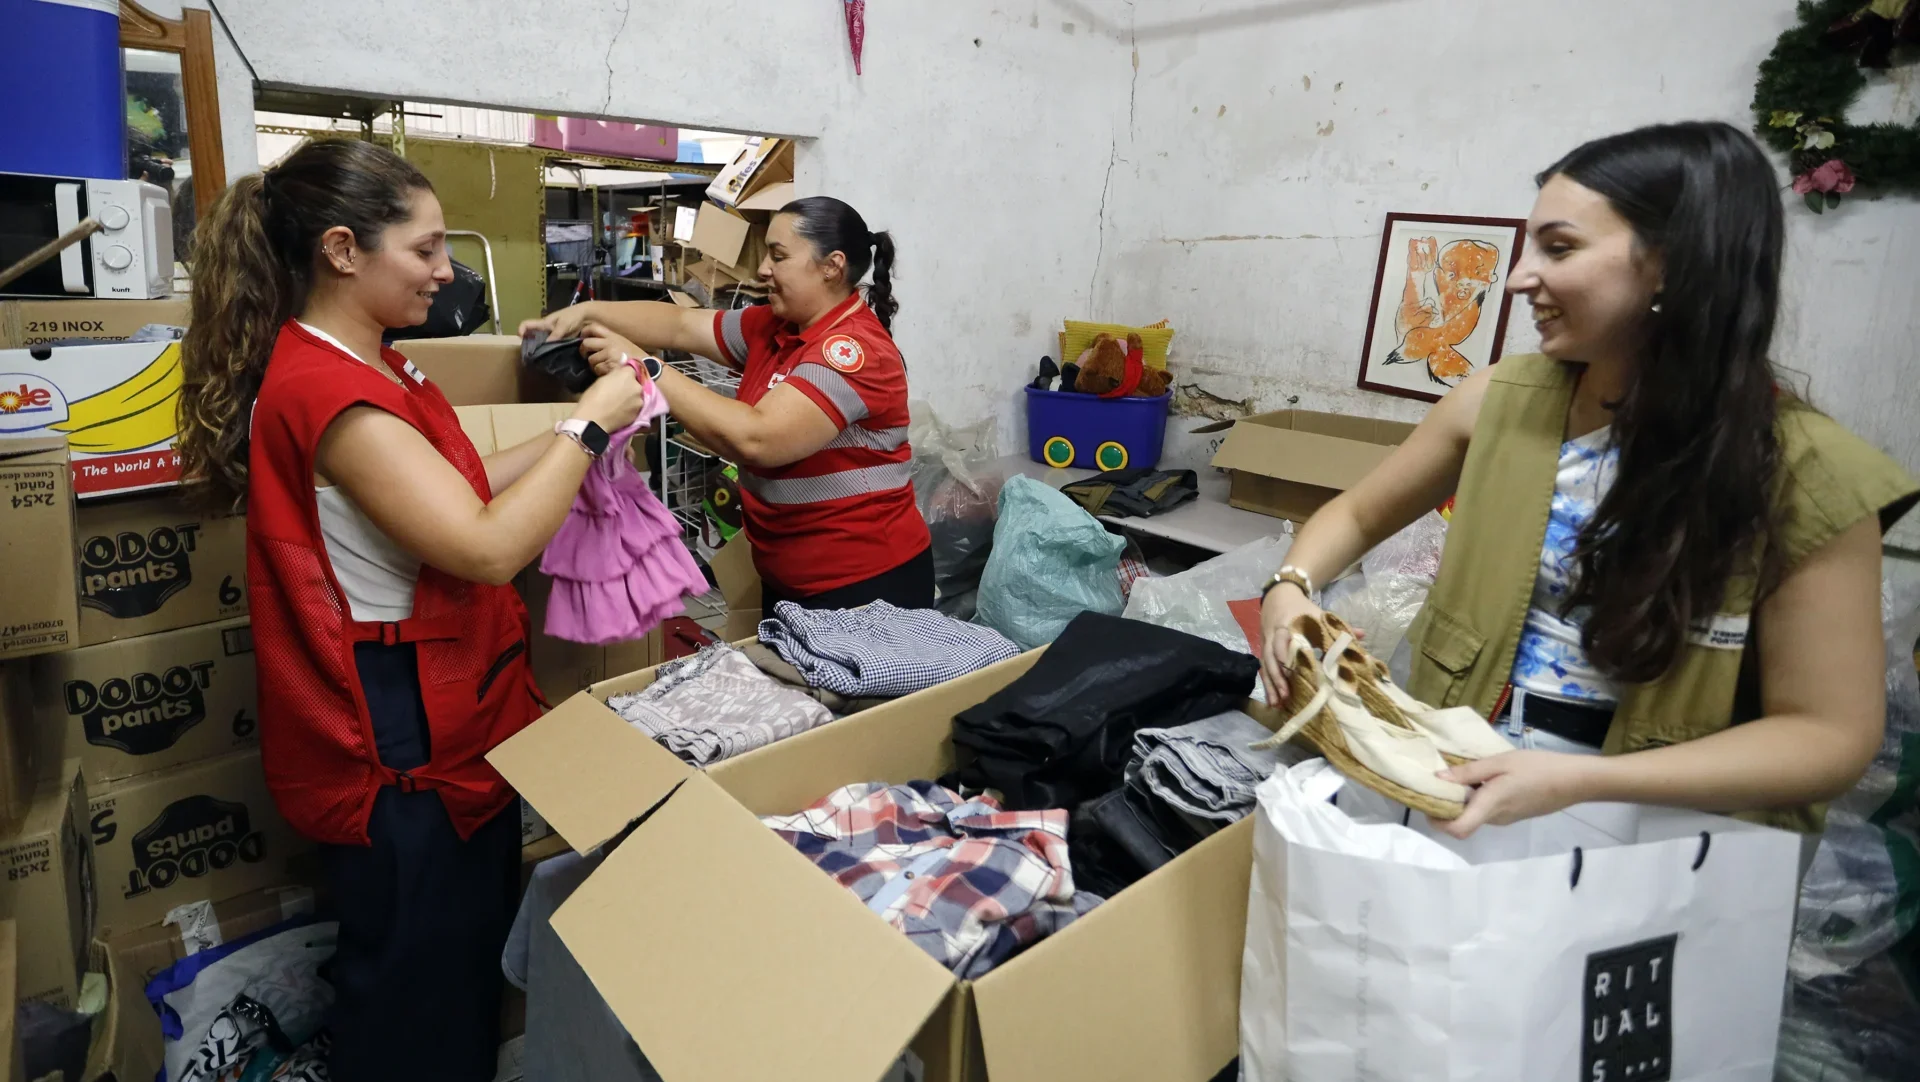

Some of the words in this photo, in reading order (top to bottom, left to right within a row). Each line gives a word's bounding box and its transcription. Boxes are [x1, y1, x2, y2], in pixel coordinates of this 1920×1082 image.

[63, 320, 104, 332] INOX
[0, 384, 51, 413] ole
[82, 465, 108, 476] The
[114, 460, 150, 472] World
[157, 458, 165, 468] A
[11, 493, 55, 509] 2x54
[14, 481, 55, 492] Pañal
[80, 522, 199, 568] ODOT
[86, 560, 178, 596] pants
[219, 575, 241, 605] 6
[64, 660, 214, 716] DODOT
[101, 699, 192, 736] pants
[232, 709, 255, 736] 6
[147, 814, 234, 858] pants
[8, 860, 50, 881] 2x58
[124, 831, 267, 900] DODOT
[1594, 957, 1662, 998] RIT
[1593, 1002, 1660, 1043] UAL
